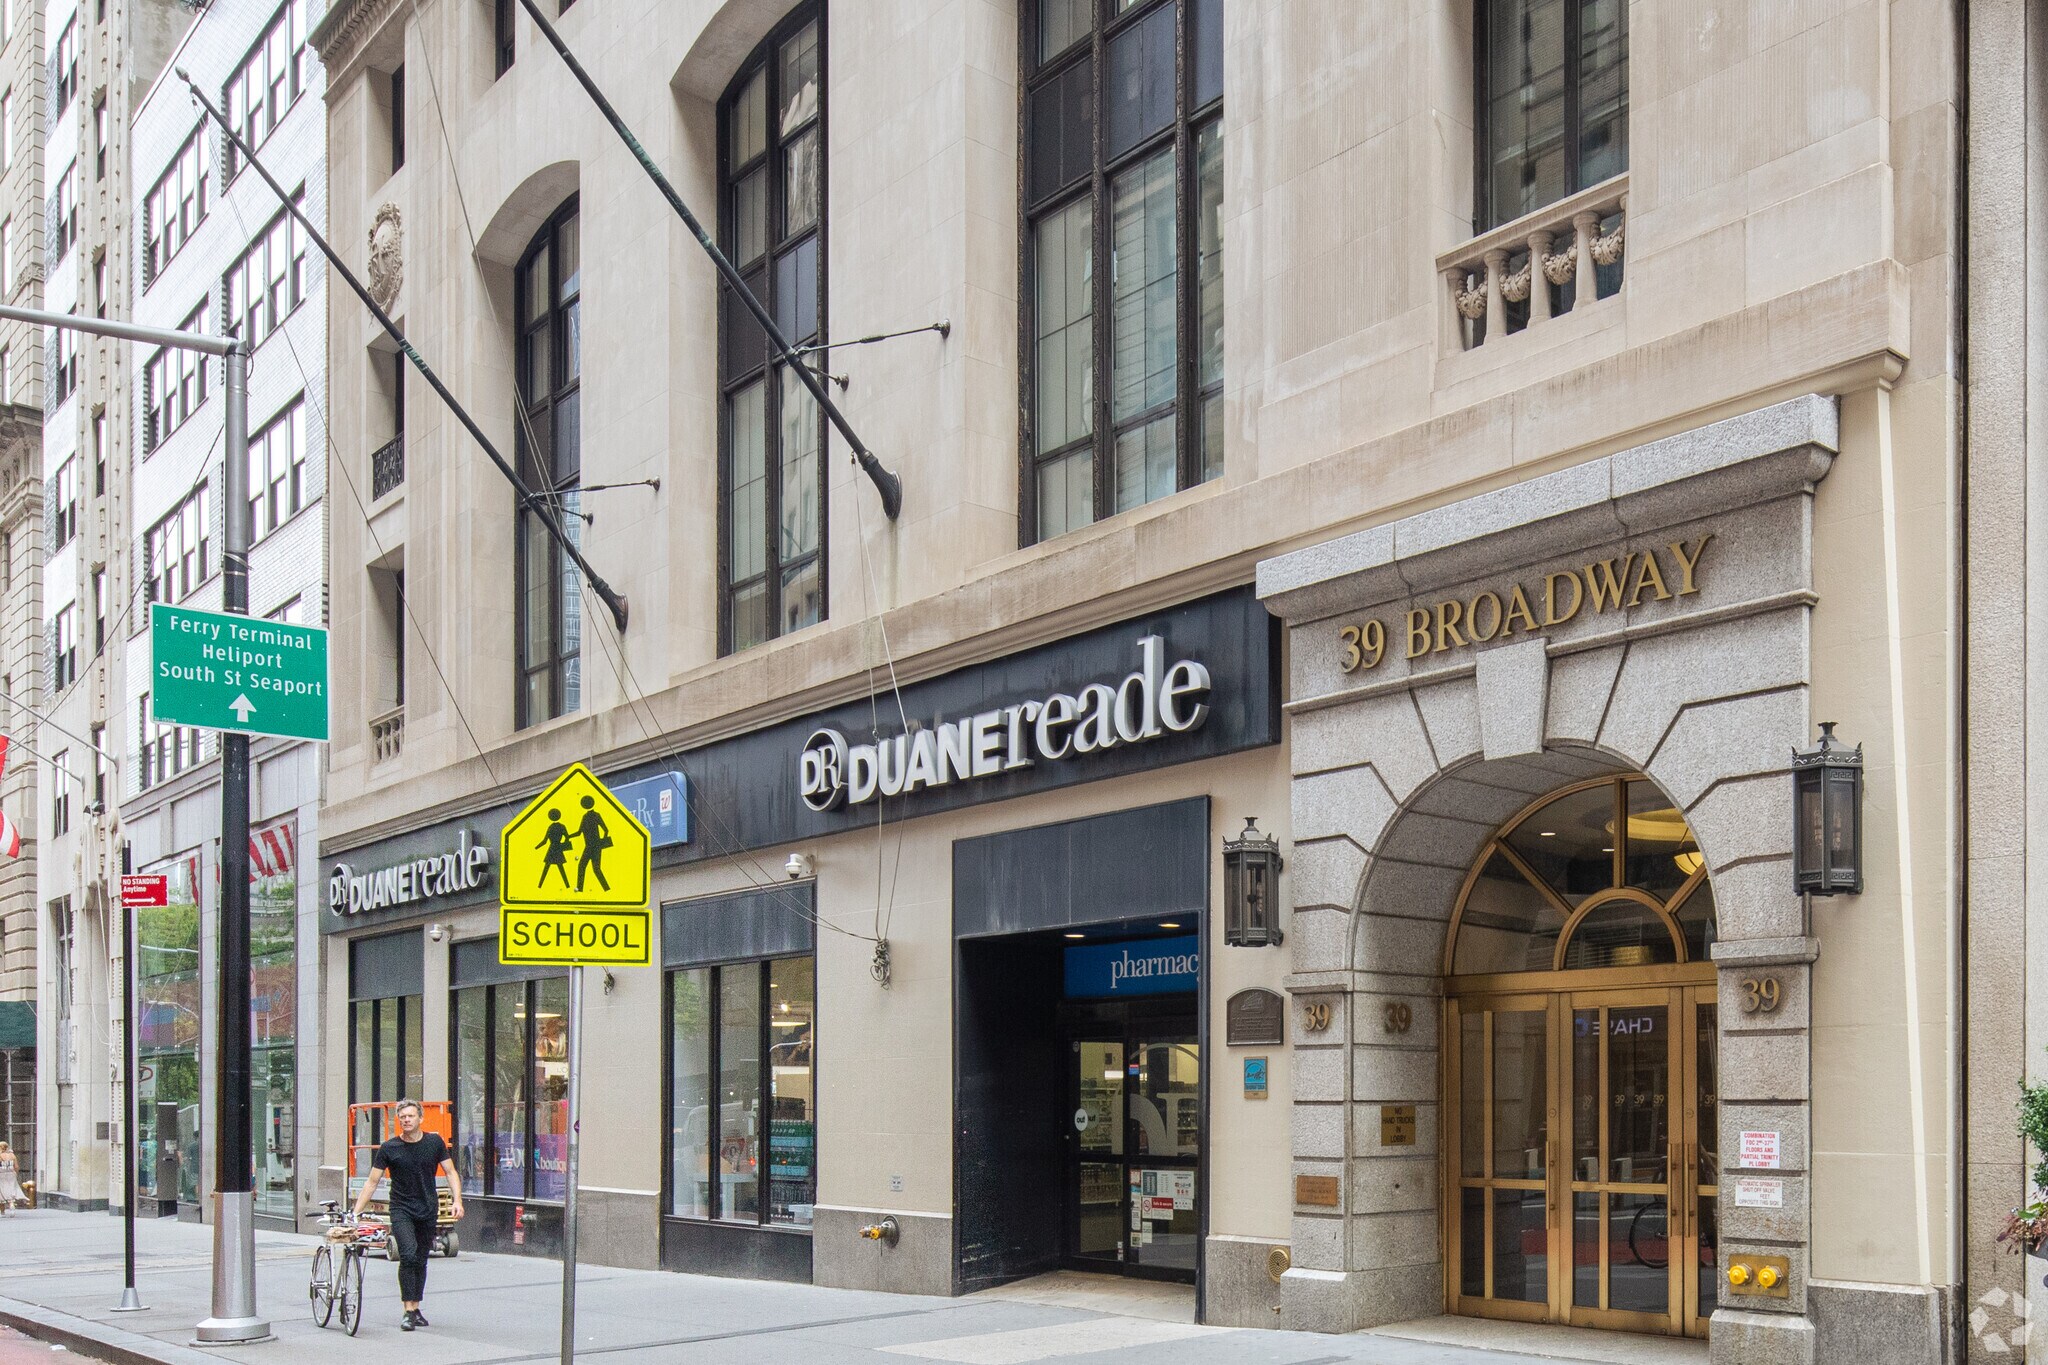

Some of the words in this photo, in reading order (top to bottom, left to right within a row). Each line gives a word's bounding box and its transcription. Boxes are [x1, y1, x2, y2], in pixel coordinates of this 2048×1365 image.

[1339, 619, 1387, 674] 39
[1404, 534, 1714, 660] BROADWAY
[170, 615, 220, 640] Ferry
[229, 623, 312, 650] Terminal
[202, 643, 282, 668] Heliport
[159, 661, 215, 683] South
[224, 669, 241, 686] St
[250, 673, 322, 696] Seaport
[132, 877, 160, 885] STANDING
[512, 921, 640, 949] SCHOOL
[1110, 950, 1199, 988] pharmac
[1741, 977, 1780, 1013] 39
[1304, 1003, 1330, 1031] 39
[1384, 1003, 1411, 1033] 39
